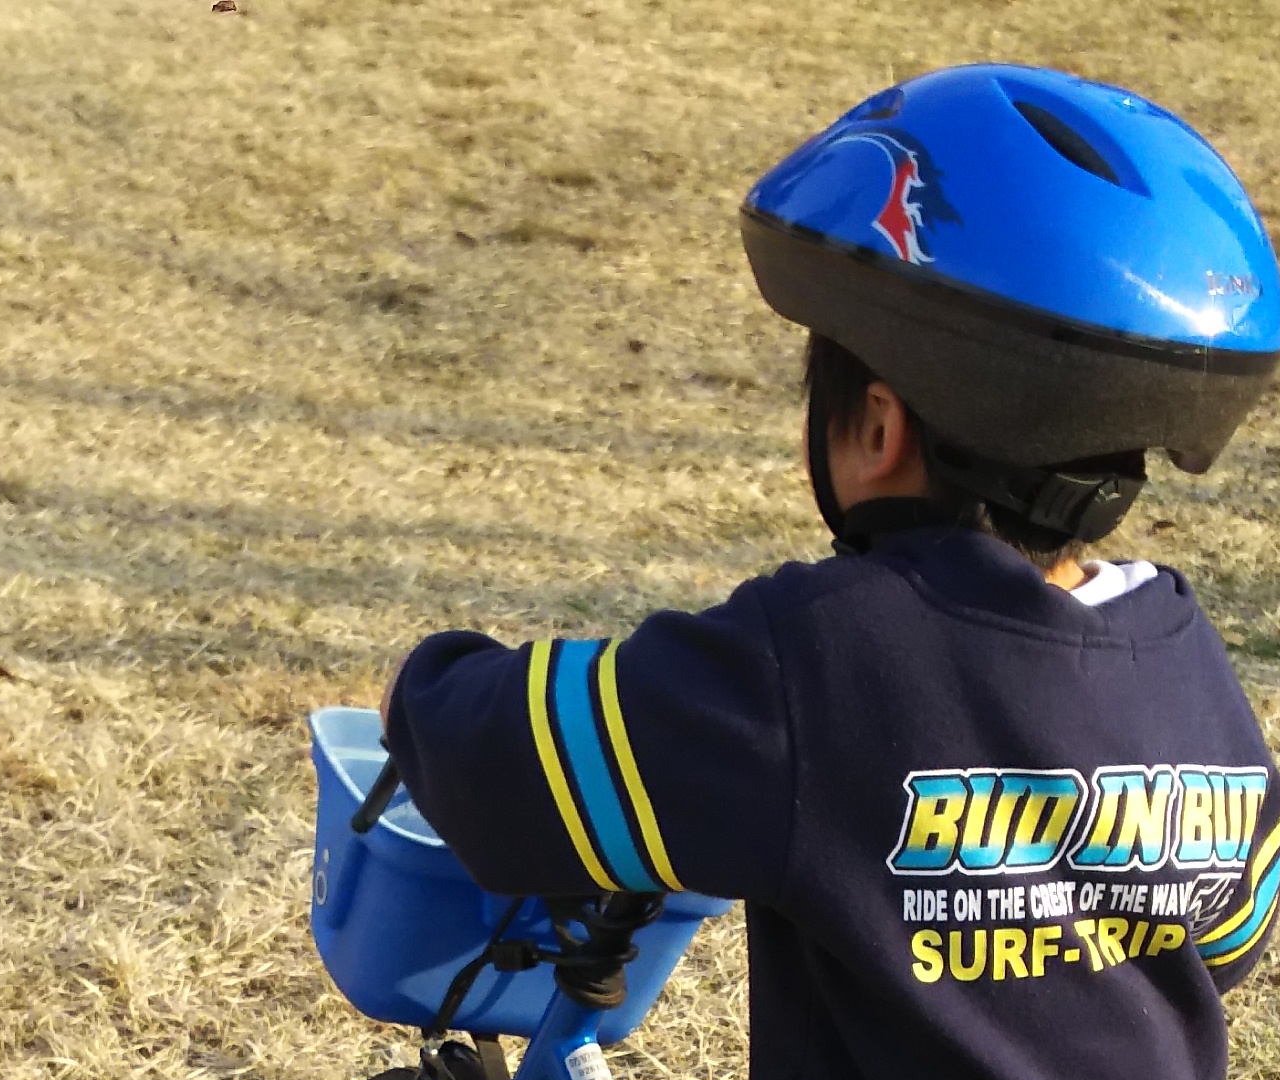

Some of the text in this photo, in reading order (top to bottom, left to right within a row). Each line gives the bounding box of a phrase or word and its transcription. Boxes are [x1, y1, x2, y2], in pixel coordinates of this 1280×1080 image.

[887, 768, 1089, 875] BUD
[1066, 765, 1177, 872] IN
[903, 880, 1193, 921] RIDE ON THE CREST OF THE WAV
[911, 917, 1186, 983] SURF-TRIP
